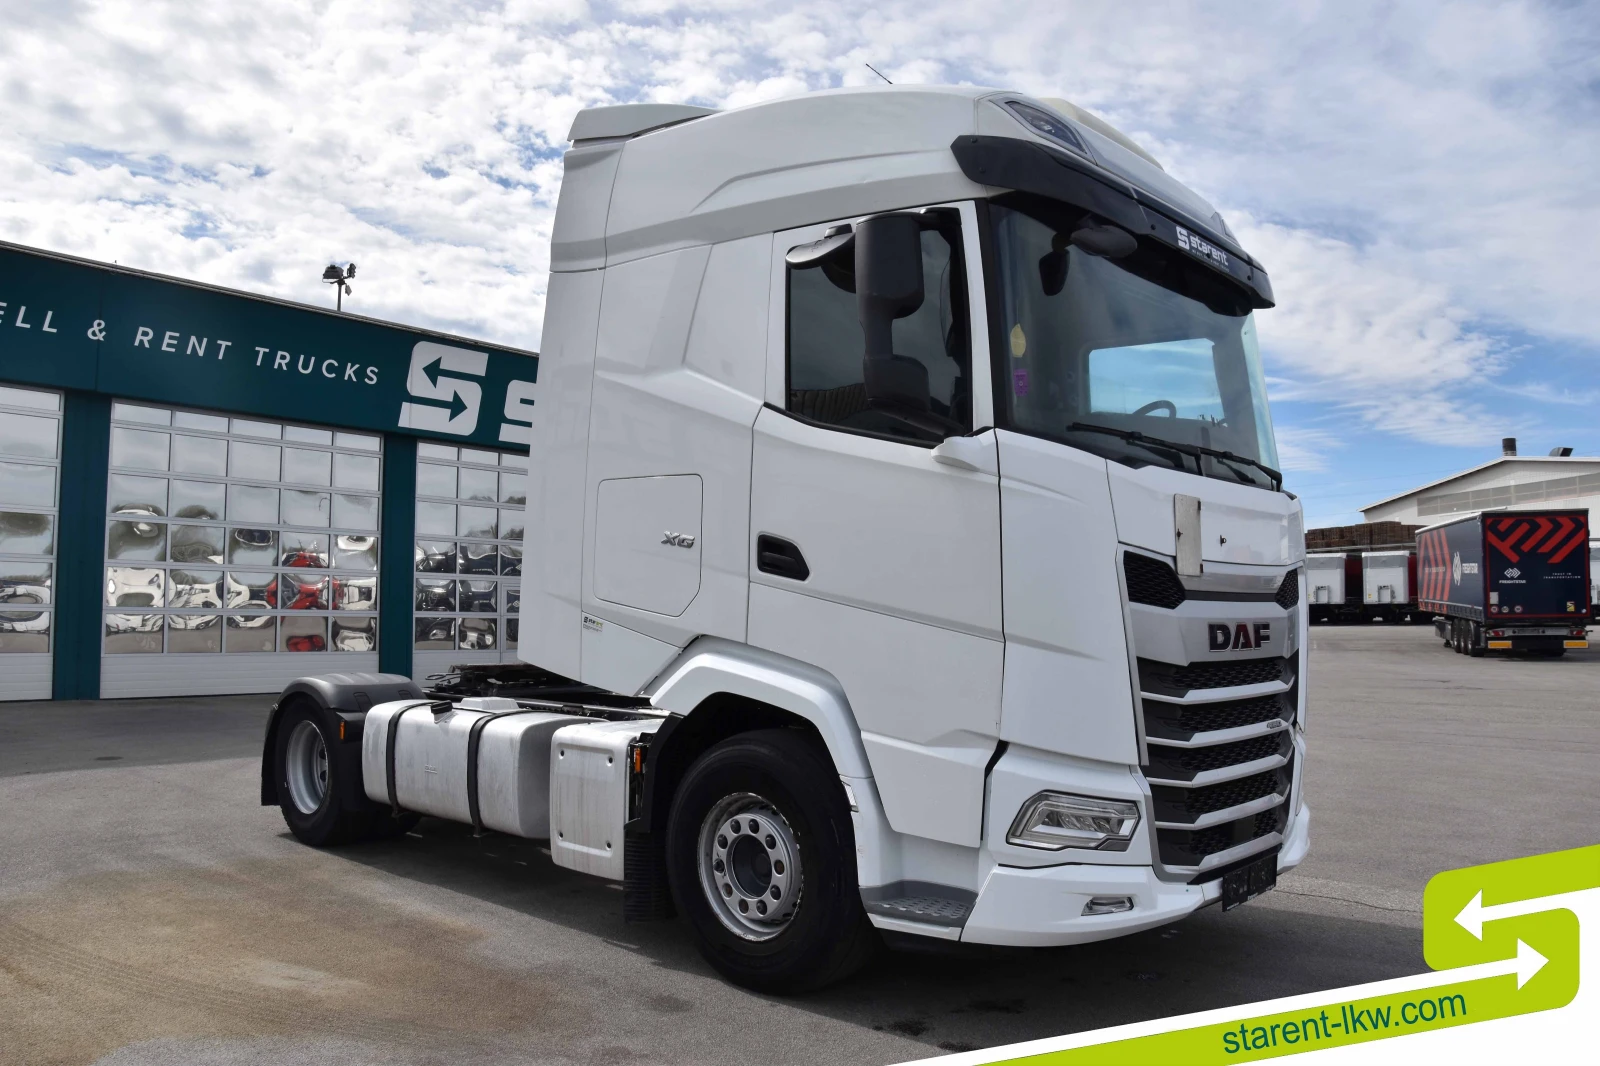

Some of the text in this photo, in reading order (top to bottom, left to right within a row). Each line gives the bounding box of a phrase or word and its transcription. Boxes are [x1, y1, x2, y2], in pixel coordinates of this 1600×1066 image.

[1190, 235, 1229, 266] starent
[87, 319, 107, 341] &
[134, 326, 233, 360] RENT
[254, 346, 380, 385] TRUCKS
[660, 530, 696, 549] XG
[1206, 622, 1271, 652] DAF
